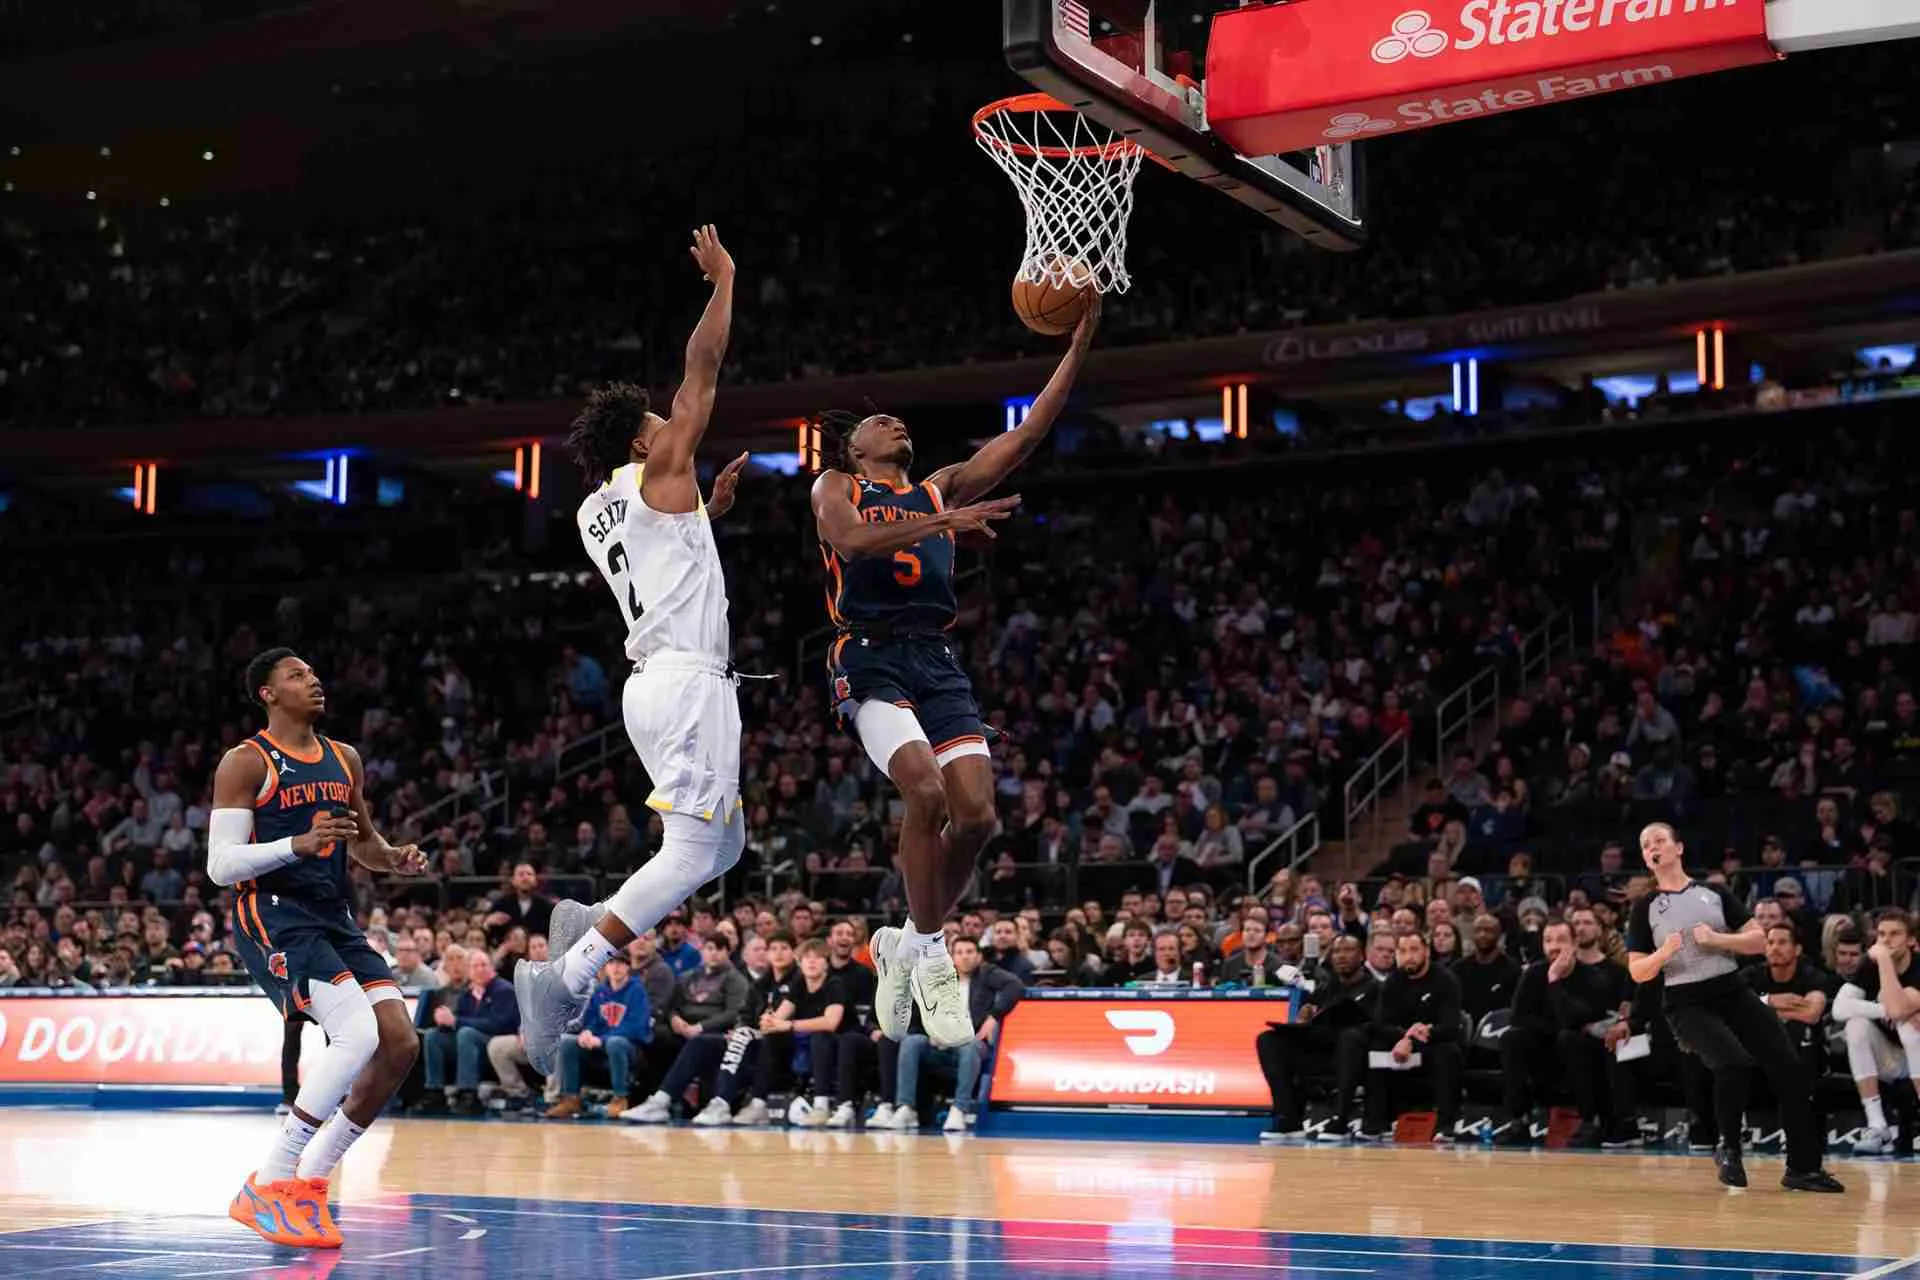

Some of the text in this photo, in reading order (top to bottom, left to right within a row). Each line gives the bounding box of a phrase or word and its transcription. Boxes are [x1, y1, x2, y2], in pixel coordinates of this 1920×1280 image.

[1537, 304, 1608, 335] LEVEL
[608, 541, 644, 621] 2
[894, 542, 922, 589] 5
[279, 784, 316, 810] NEW
[17, 1016, 278, 1062] DOORDAS
[1055, 1070, 1216, 1096] DOORDASH
